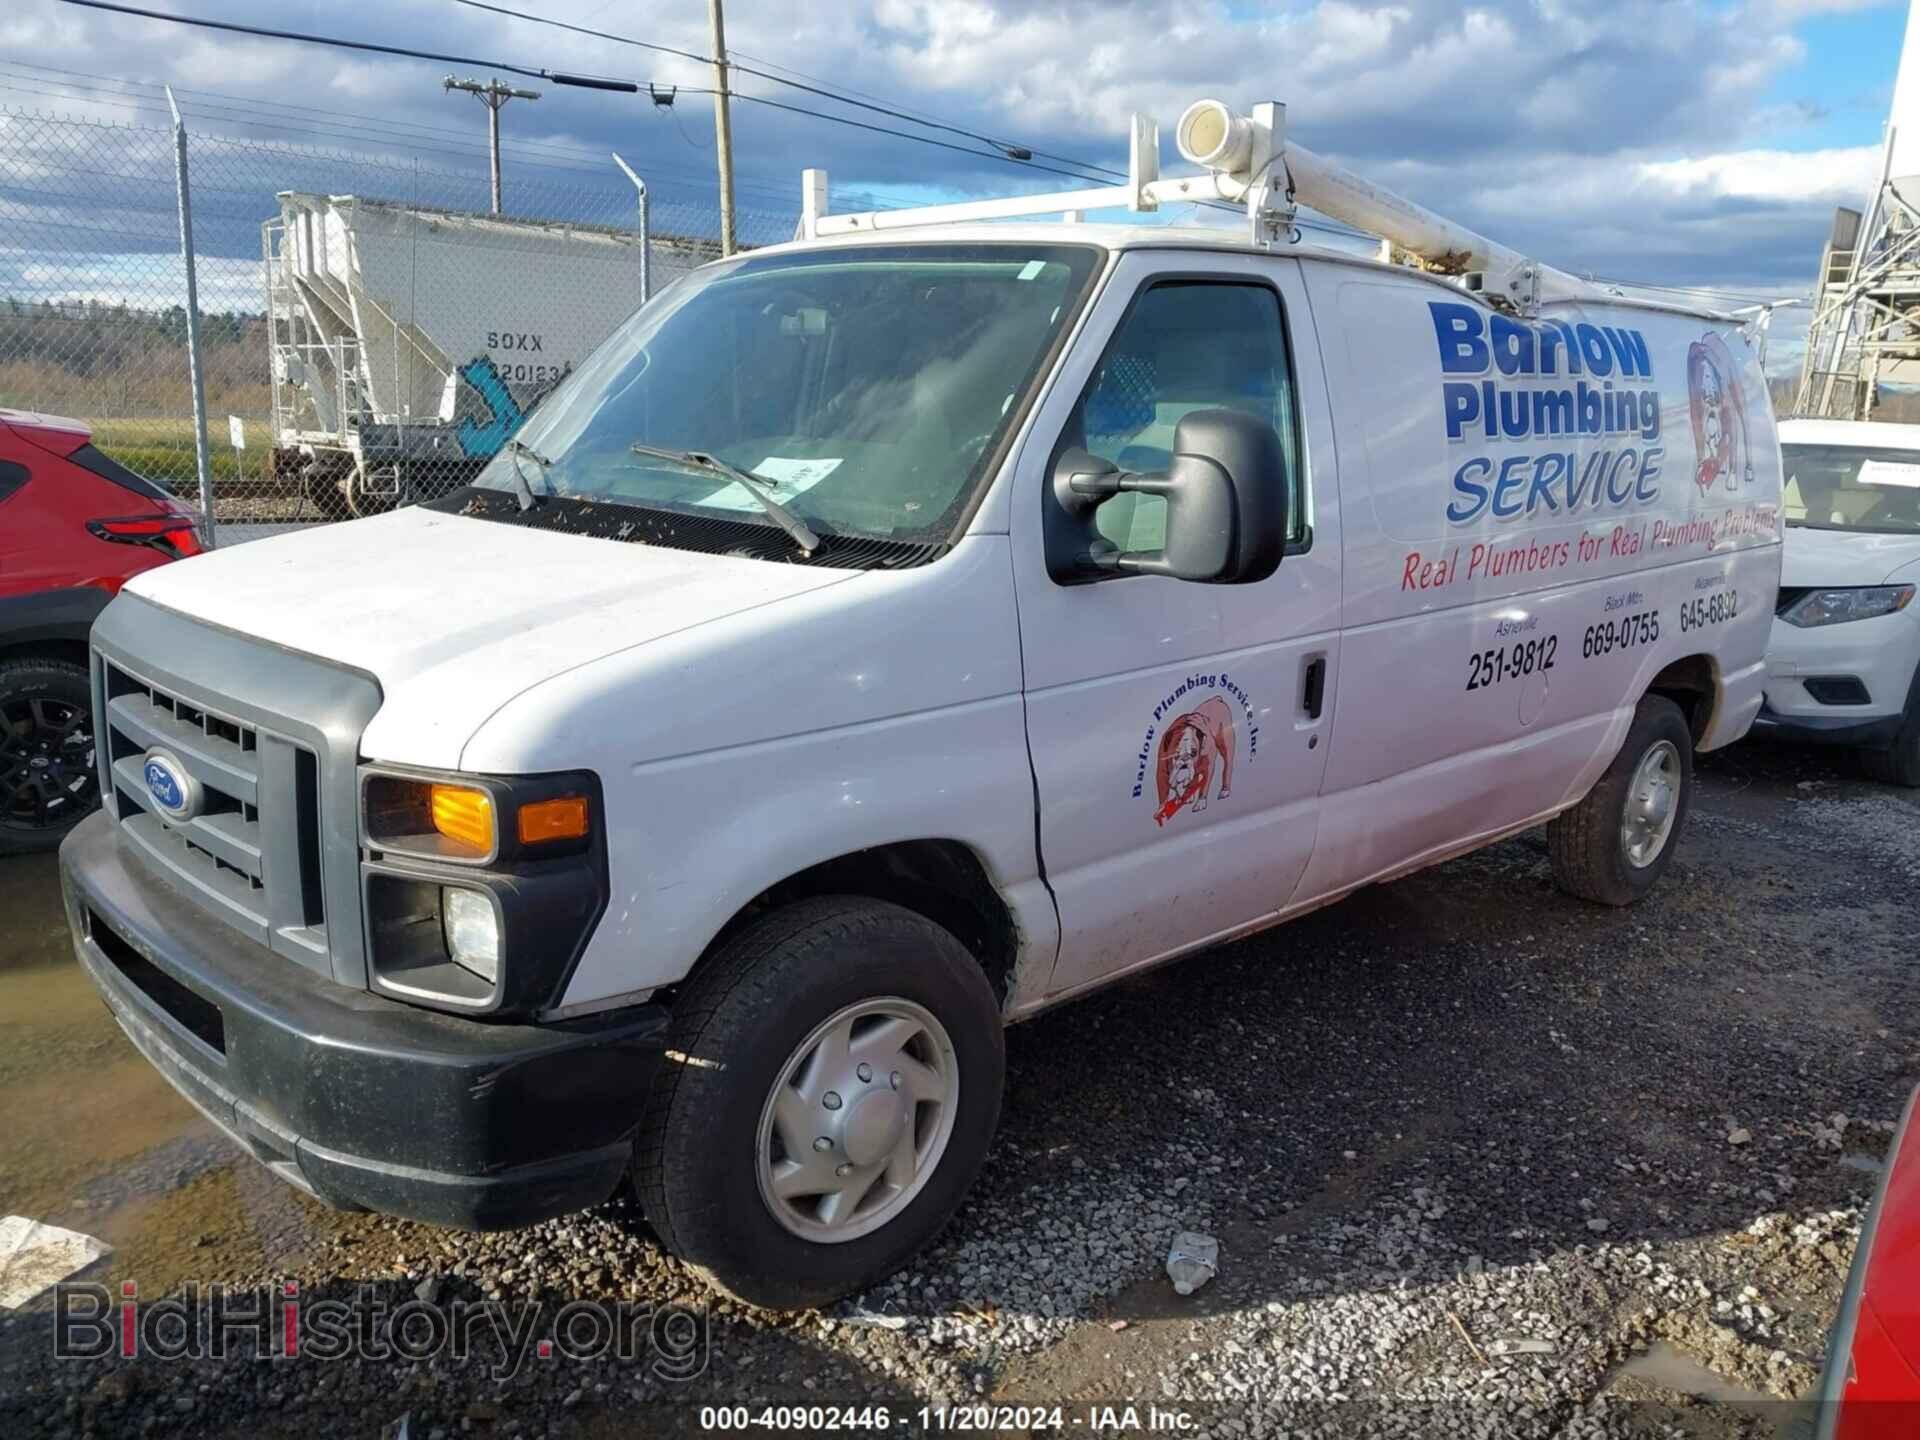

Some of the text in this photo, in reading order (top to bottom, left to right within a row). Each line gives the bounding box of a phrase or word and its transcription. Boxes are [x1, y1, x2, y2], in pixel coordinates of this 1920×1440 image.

[487, 332, 543, 352] SOXX
[1428, 302, 1652, 377] Barlow
[1442, 380, 1661, 443] Plumbing
[1446, 447, 1664, 524] SERVICE
[1402, 504, 1777, 592] Real Plumbers for Real Plumbing Problems
[1583, 610, 1660, 658] 669-0755
[1680, 589, 1738, 633] 645-6892
[1466, 634, 1558, 691] 251-9812
[1131, 725, 1155, 798] Barlow
[1152, 673, 1217, 722] Plumbing
[148, 765, 172, 802] Ford
